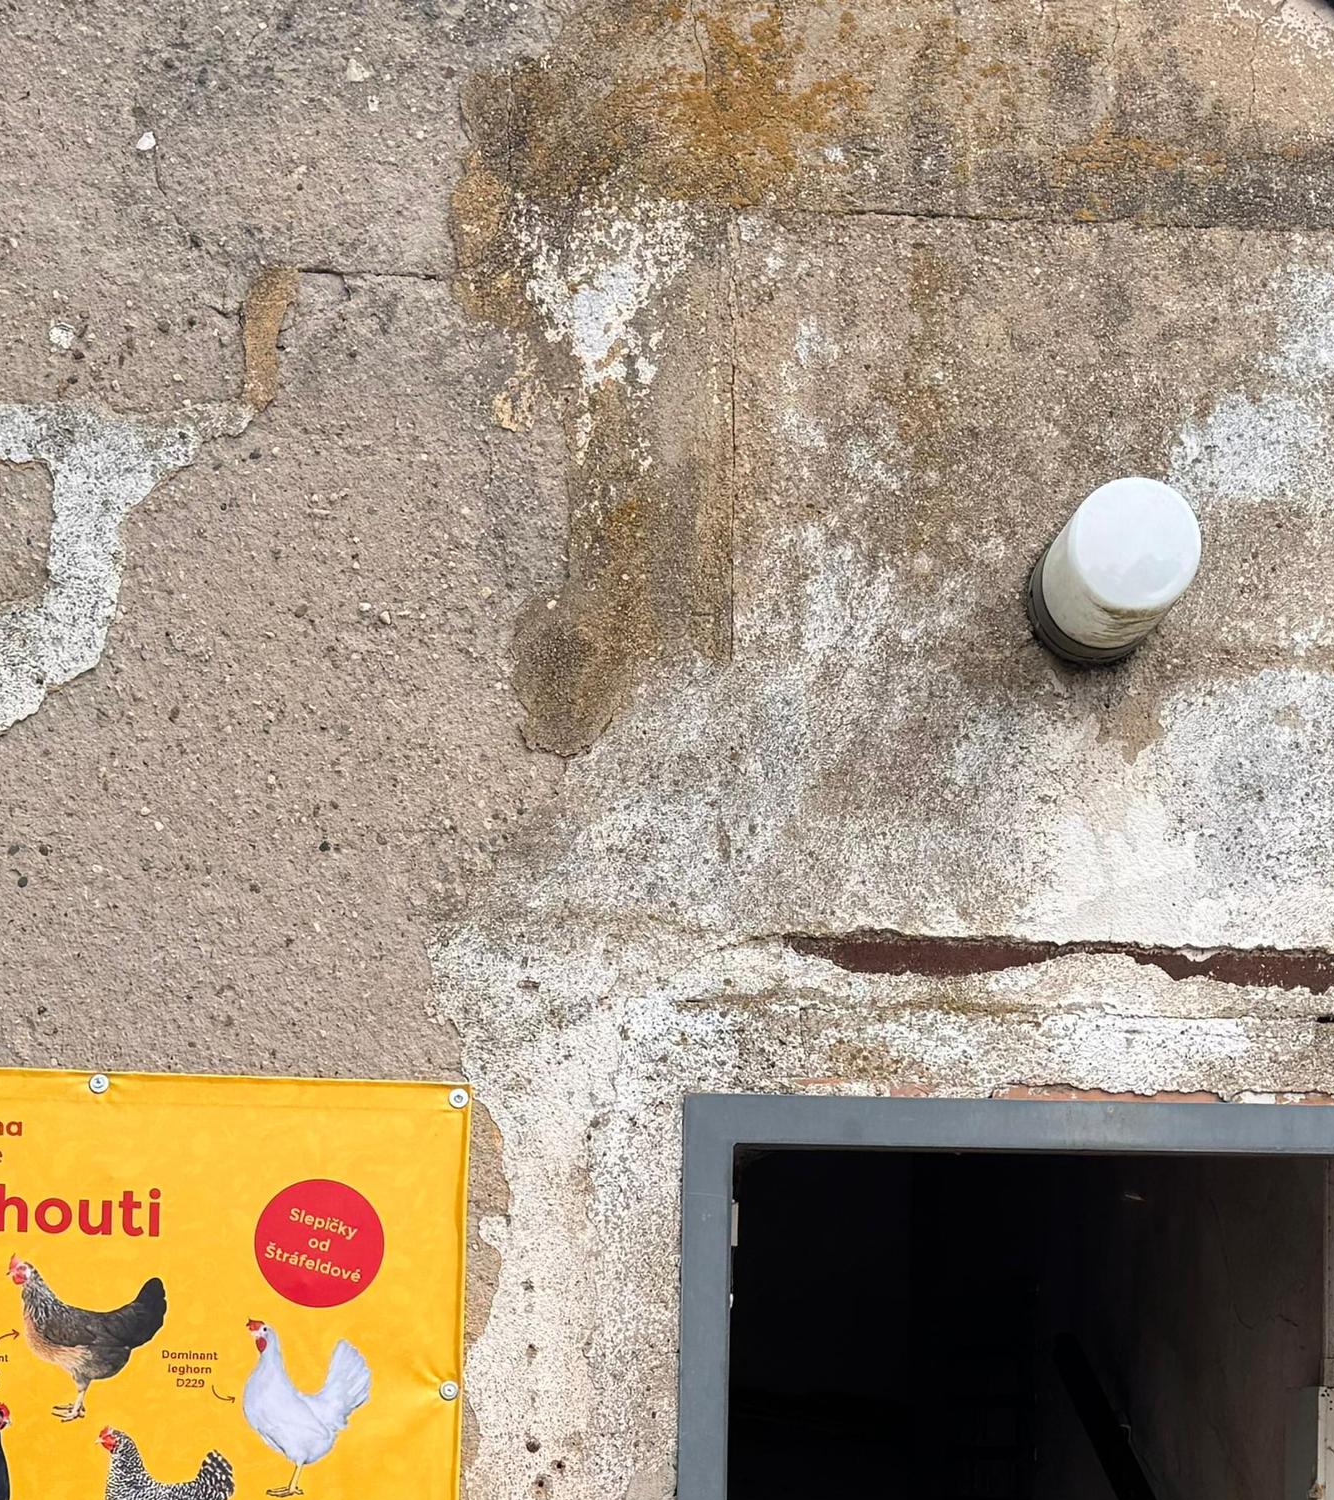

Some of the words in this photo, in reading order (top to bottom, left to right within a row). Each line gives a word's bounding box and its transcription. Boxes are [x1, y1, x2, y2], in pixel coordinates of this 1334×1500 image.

[289, 1207, 358, 1240] Slepičky
[308, 1237, 331, 1252] od
[264, 1241, 363, 1283] Štráfeldové
[161, 1349, 219, 1361] Dominant
[167, 1363, 212, 1375] leghorn
[176, 1378, 205, 1388] D229
